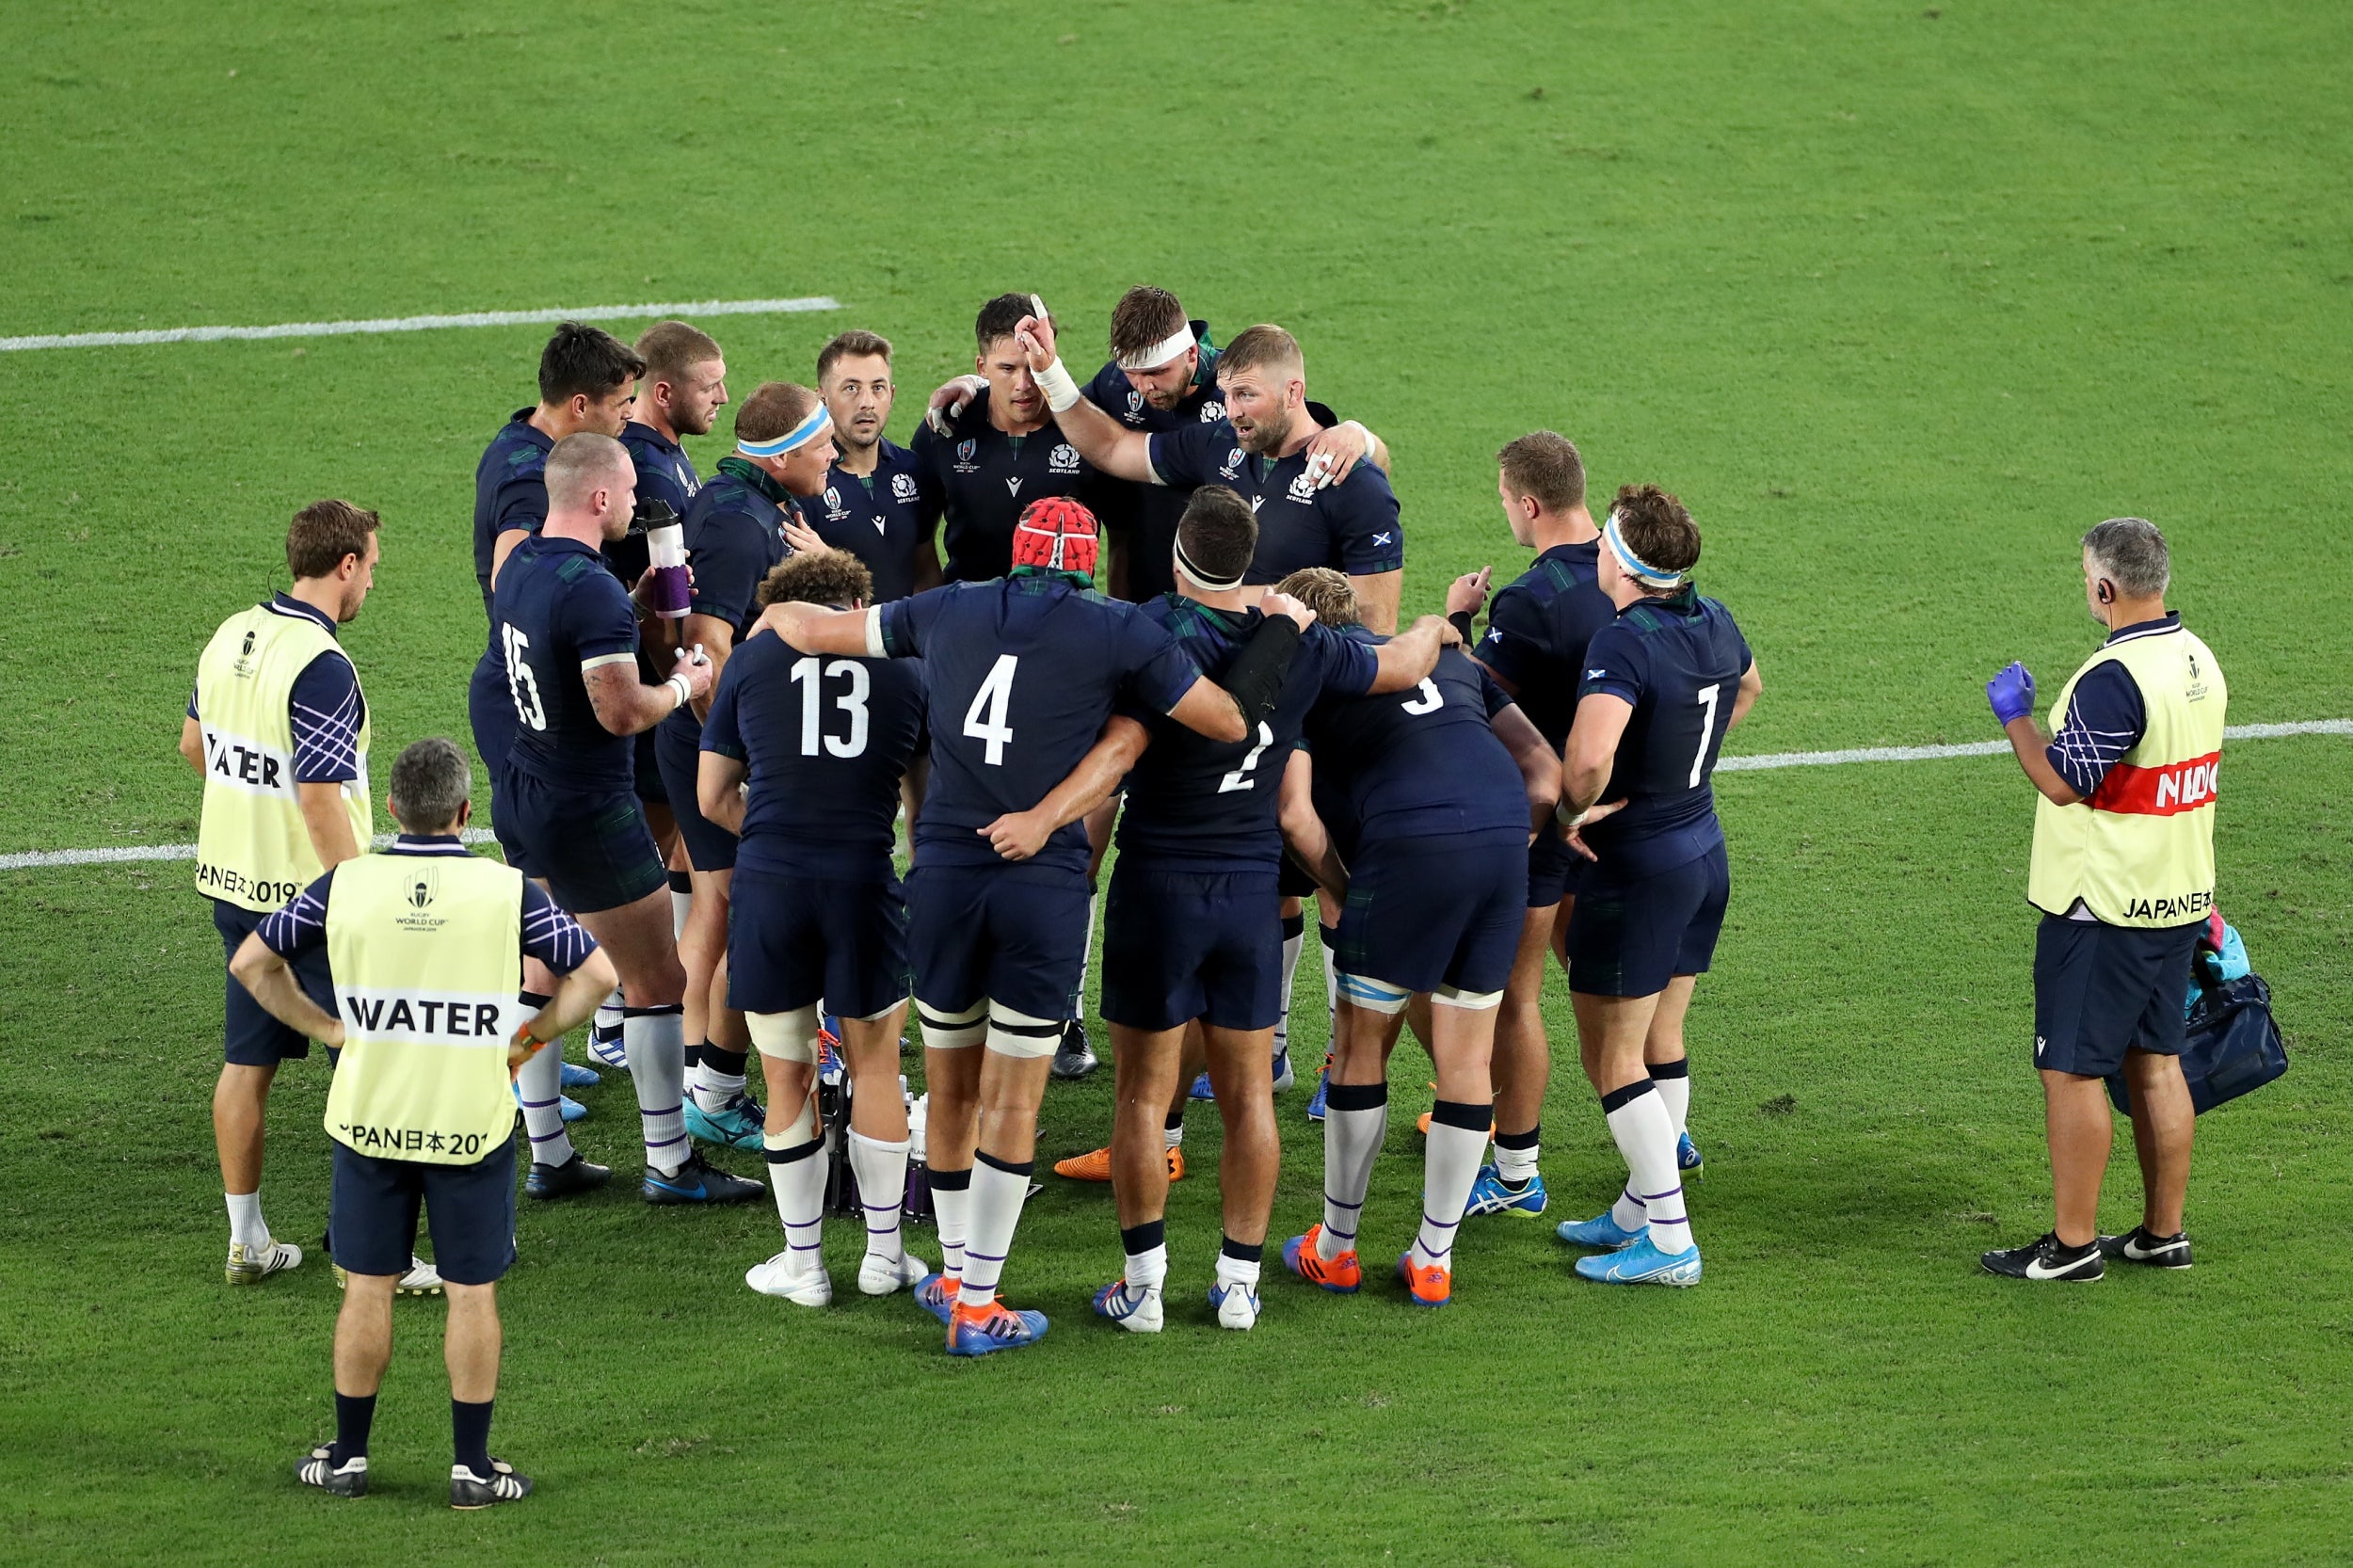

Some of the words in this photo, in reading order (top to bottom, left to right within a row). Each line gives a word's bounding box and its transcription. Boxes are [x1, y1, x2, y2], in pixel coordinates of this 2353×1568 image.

[896, 496, 920, 504] SCOTLAND
[1286, 494, 1313, 505] SCOTLAND
[502, 621, 547, 731] 15
[791, 657, 871, 759] 13
[963, 653, 1018, 766] 4
[395, 918, 427, 926] WORLD
[346, 996, 499, 1036] WATER
